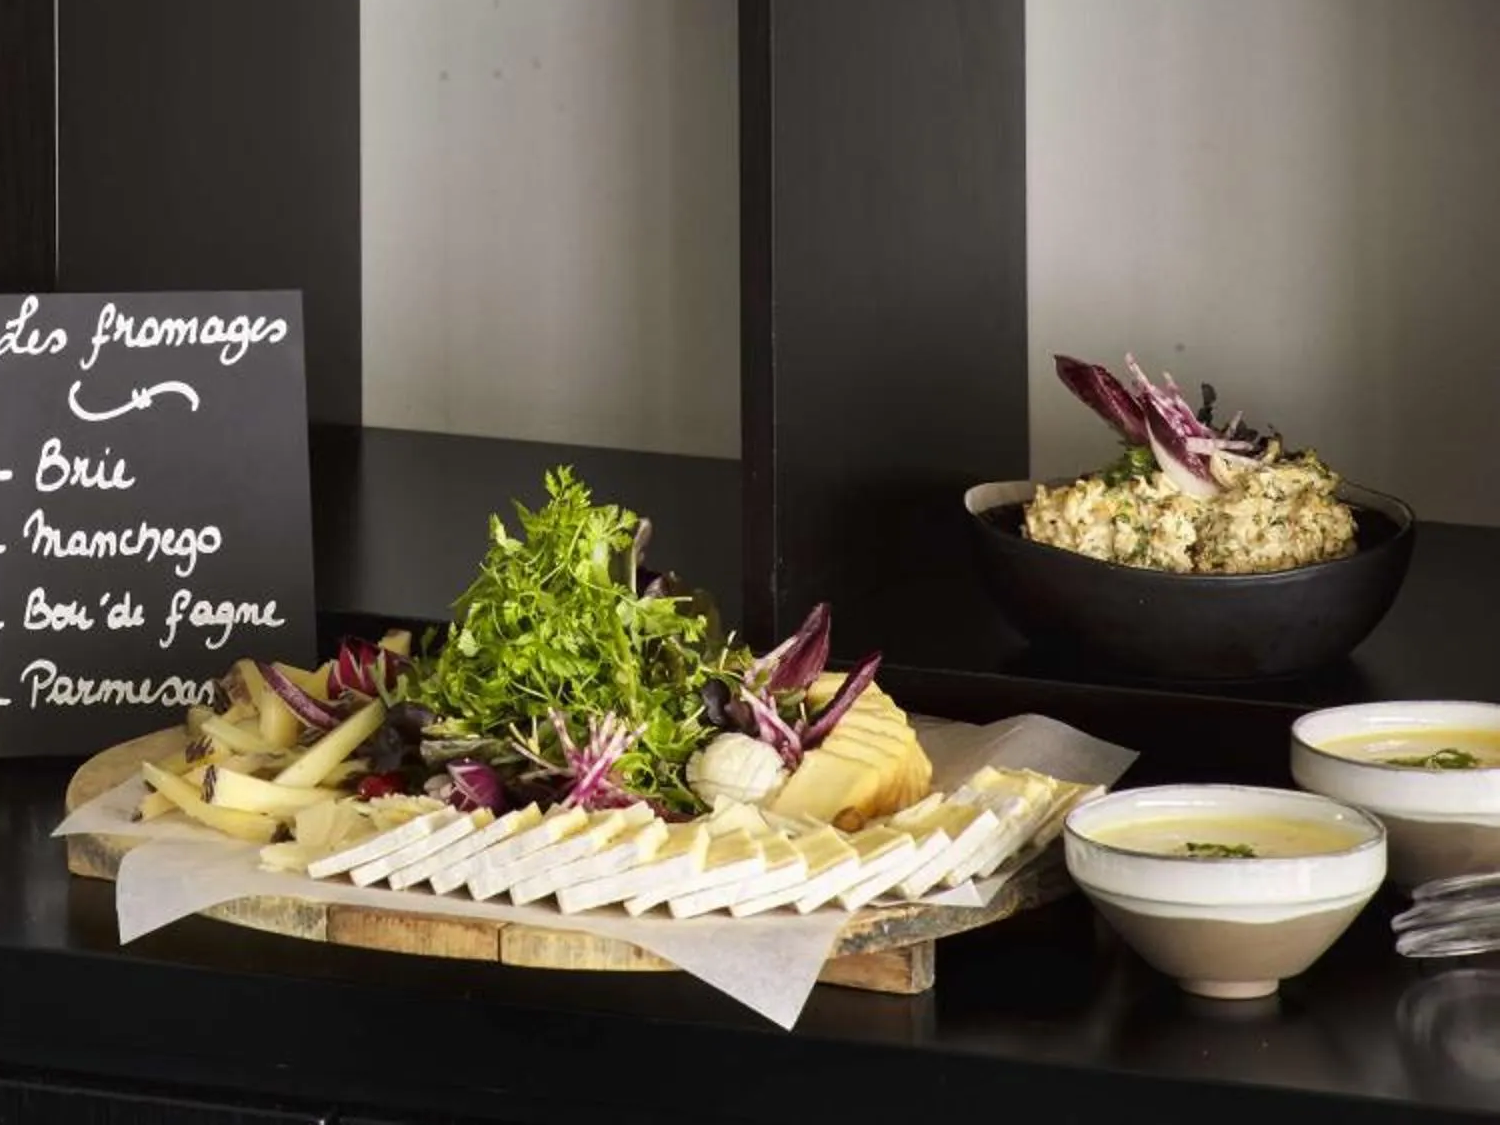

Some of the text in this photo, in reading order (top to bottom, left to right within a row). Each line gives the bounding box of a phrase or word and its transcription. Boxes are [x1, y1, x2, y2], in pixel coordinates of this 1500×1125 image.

[78, 301, 289, 371] fromages
[35, 436, 137, 493] Brie
[159, 588, 286, 650] fagne
